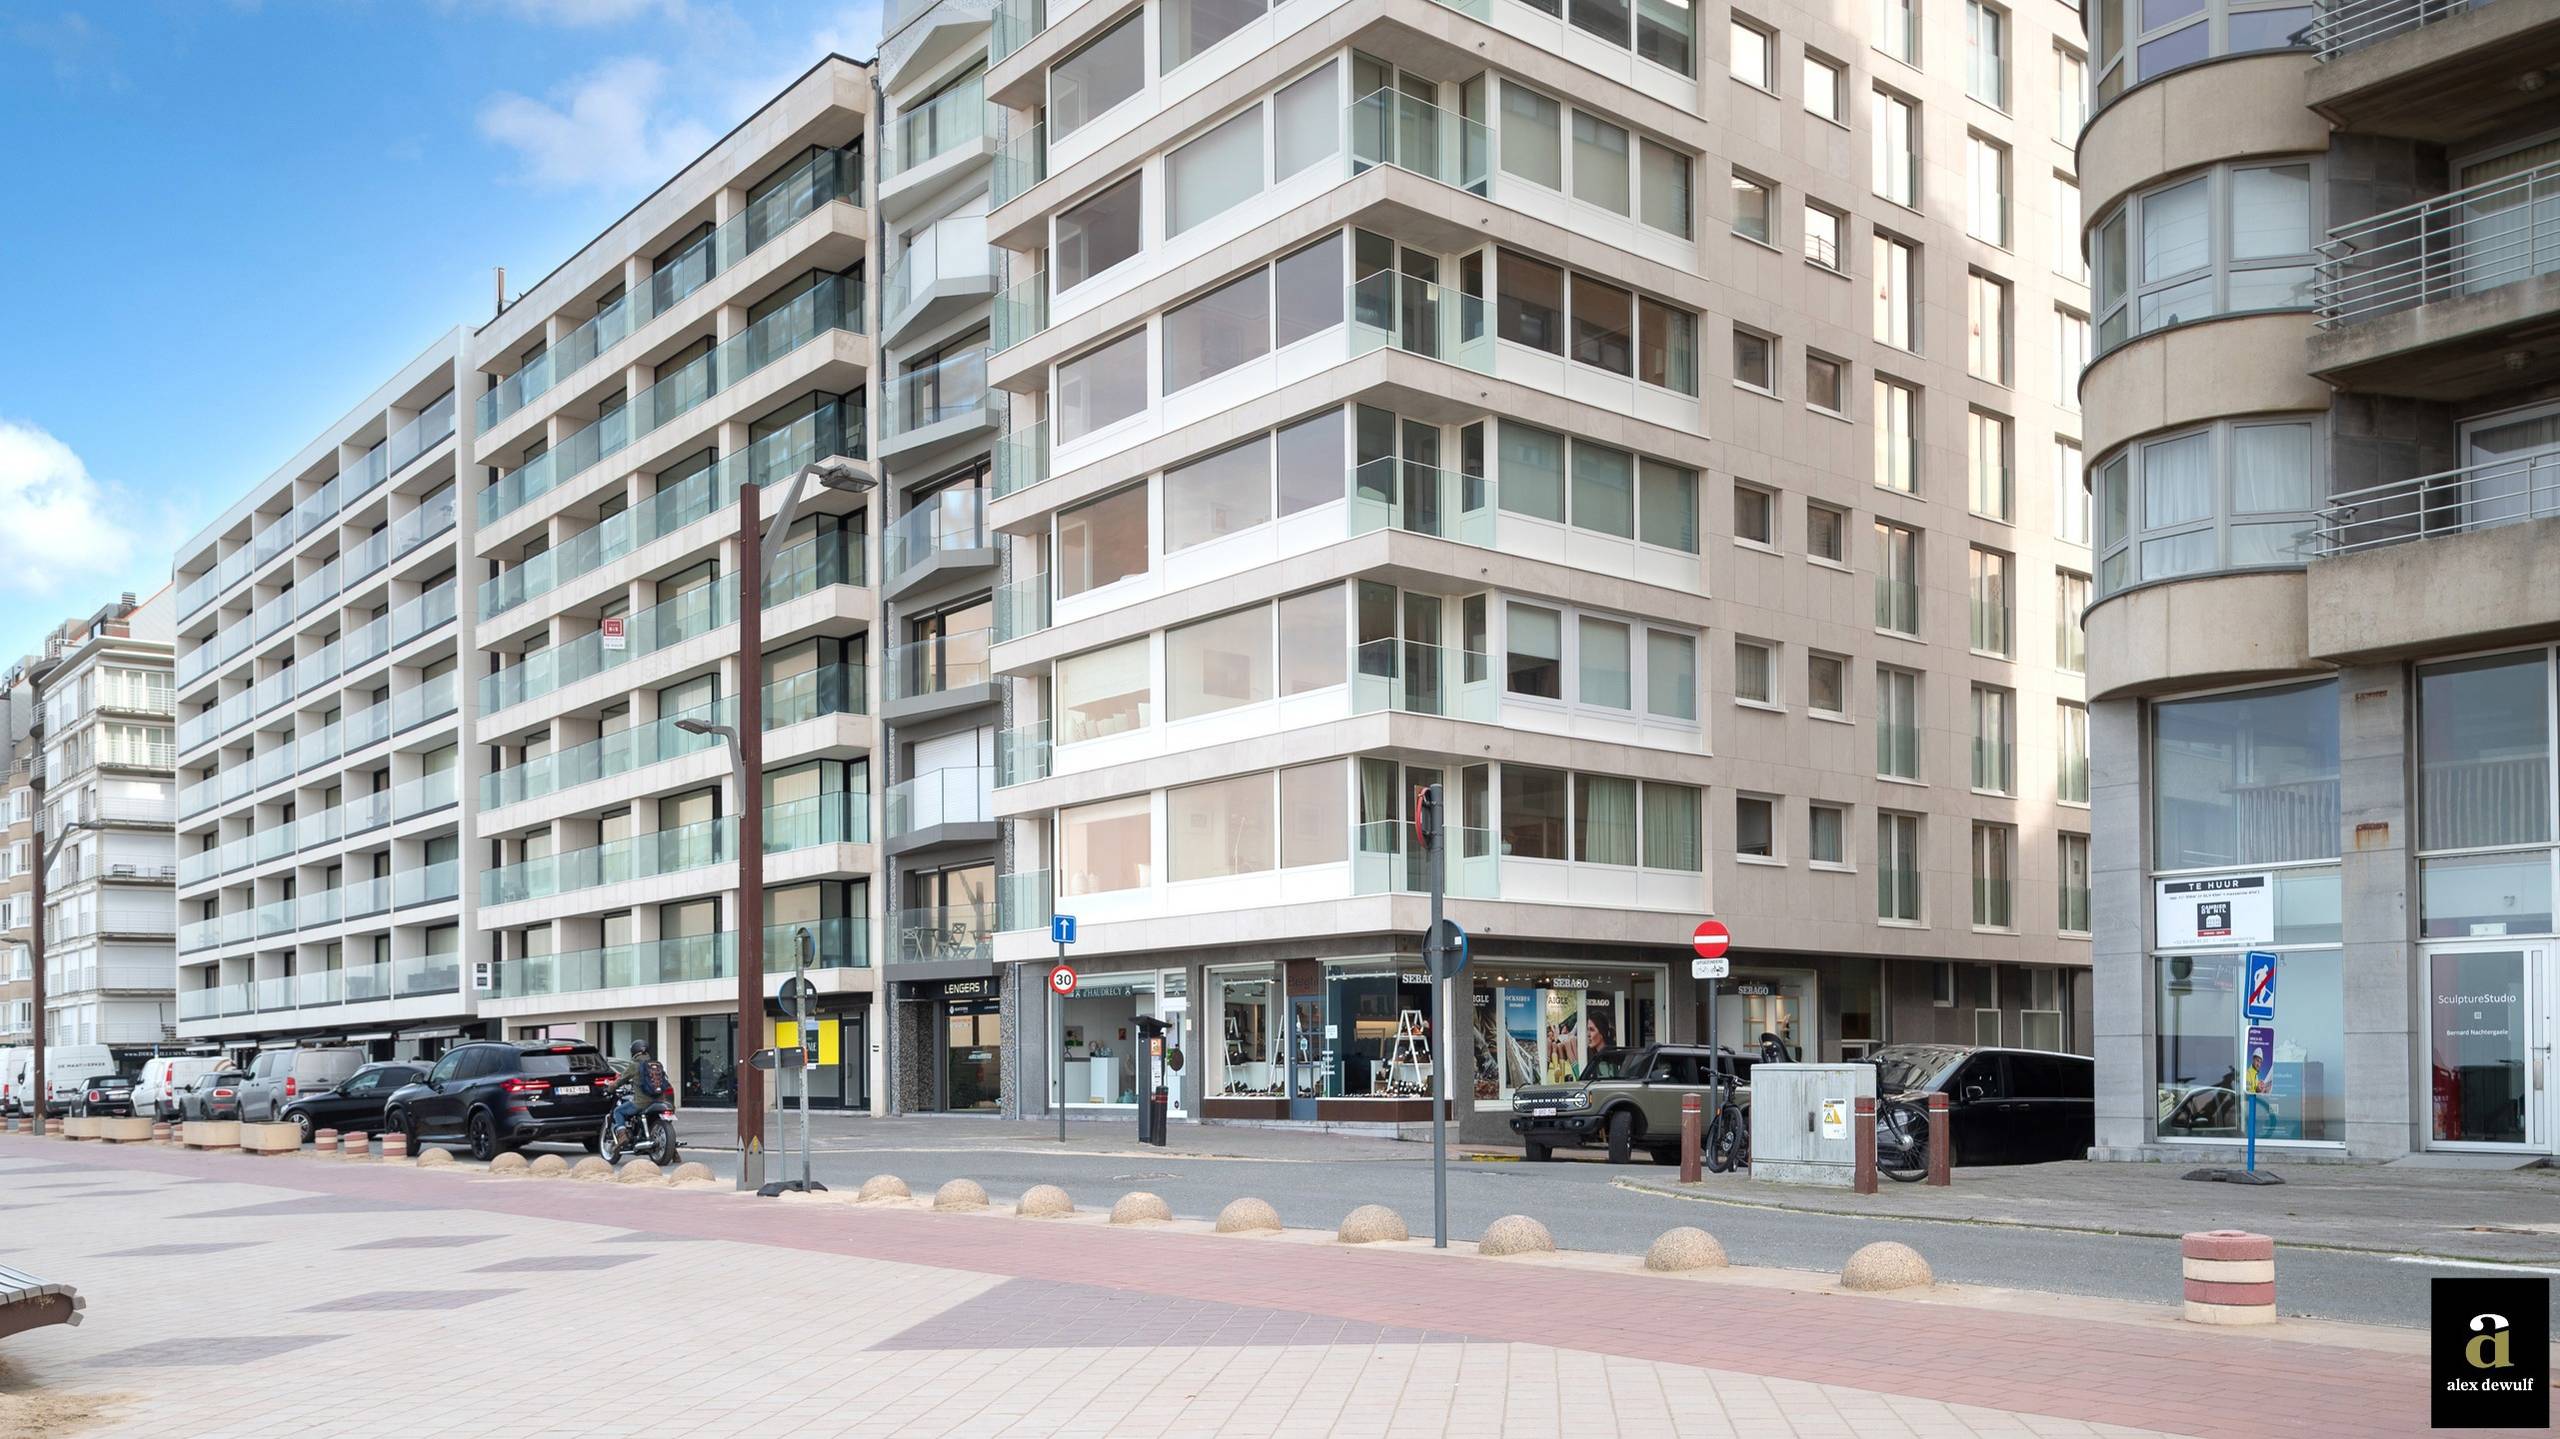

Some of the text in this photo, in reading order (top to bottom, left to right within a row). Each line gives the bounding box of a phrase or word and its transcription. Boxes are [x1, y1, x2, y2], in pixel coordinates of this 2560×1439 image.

[2189, 880, 2240, 891] TE HUUR
[1055, 974, 1072, 986] 30
[1402, 973, 1433, 984] SEBA
[1552, 978, 1590, 989] SEBAGO
[944, 982, 981, 995] LENGERS
[1738, 985, 1769, 996] SEBAGO
[1472, 994, 1490, 1003] IGLE
[1547, 996, 1569, 1005] AIGLE
[2438, 993, 2517, 1005] SculptureStudio
